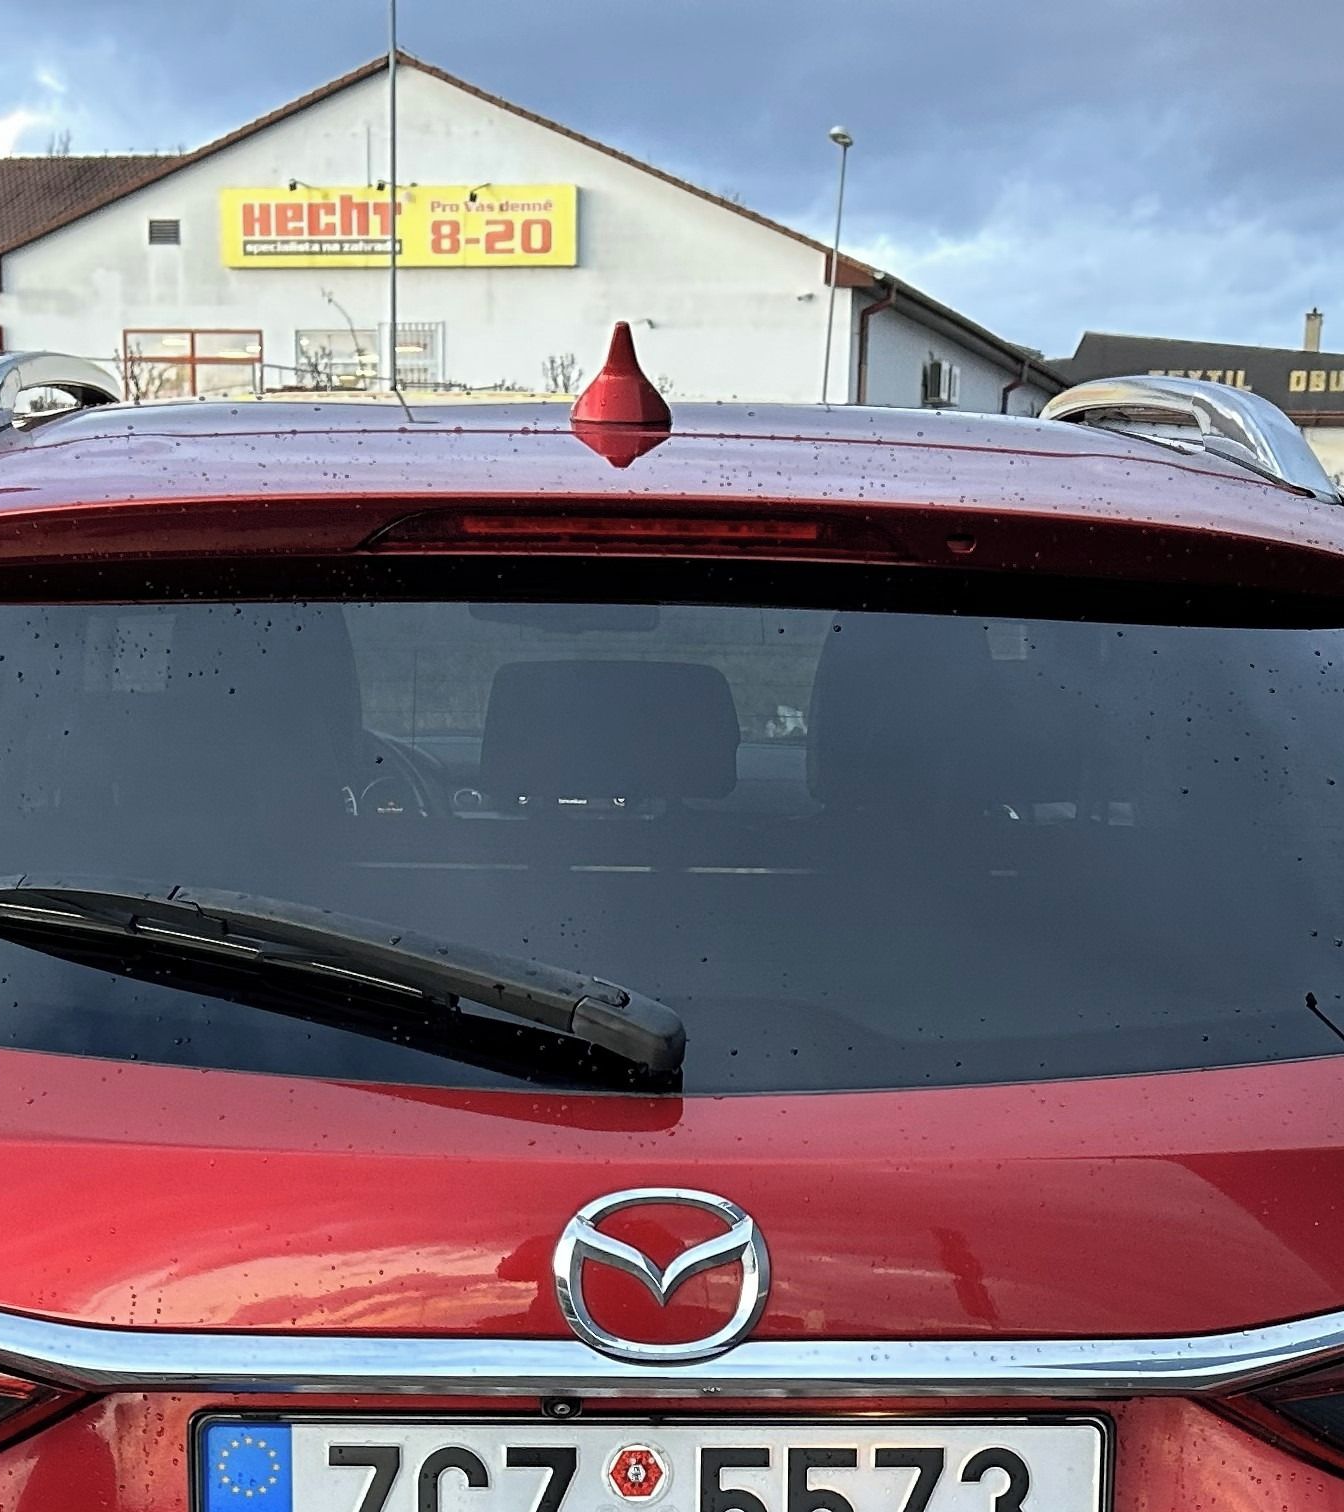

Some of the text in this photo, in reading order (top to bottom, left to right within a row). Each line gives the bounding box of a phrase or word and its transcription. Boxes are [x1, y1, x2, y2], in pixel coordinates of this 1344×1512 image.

[431, 201, 459, 213] Pro
[499, 200, 553, 213] denně
[431, 219, 552, 254] 8-20
